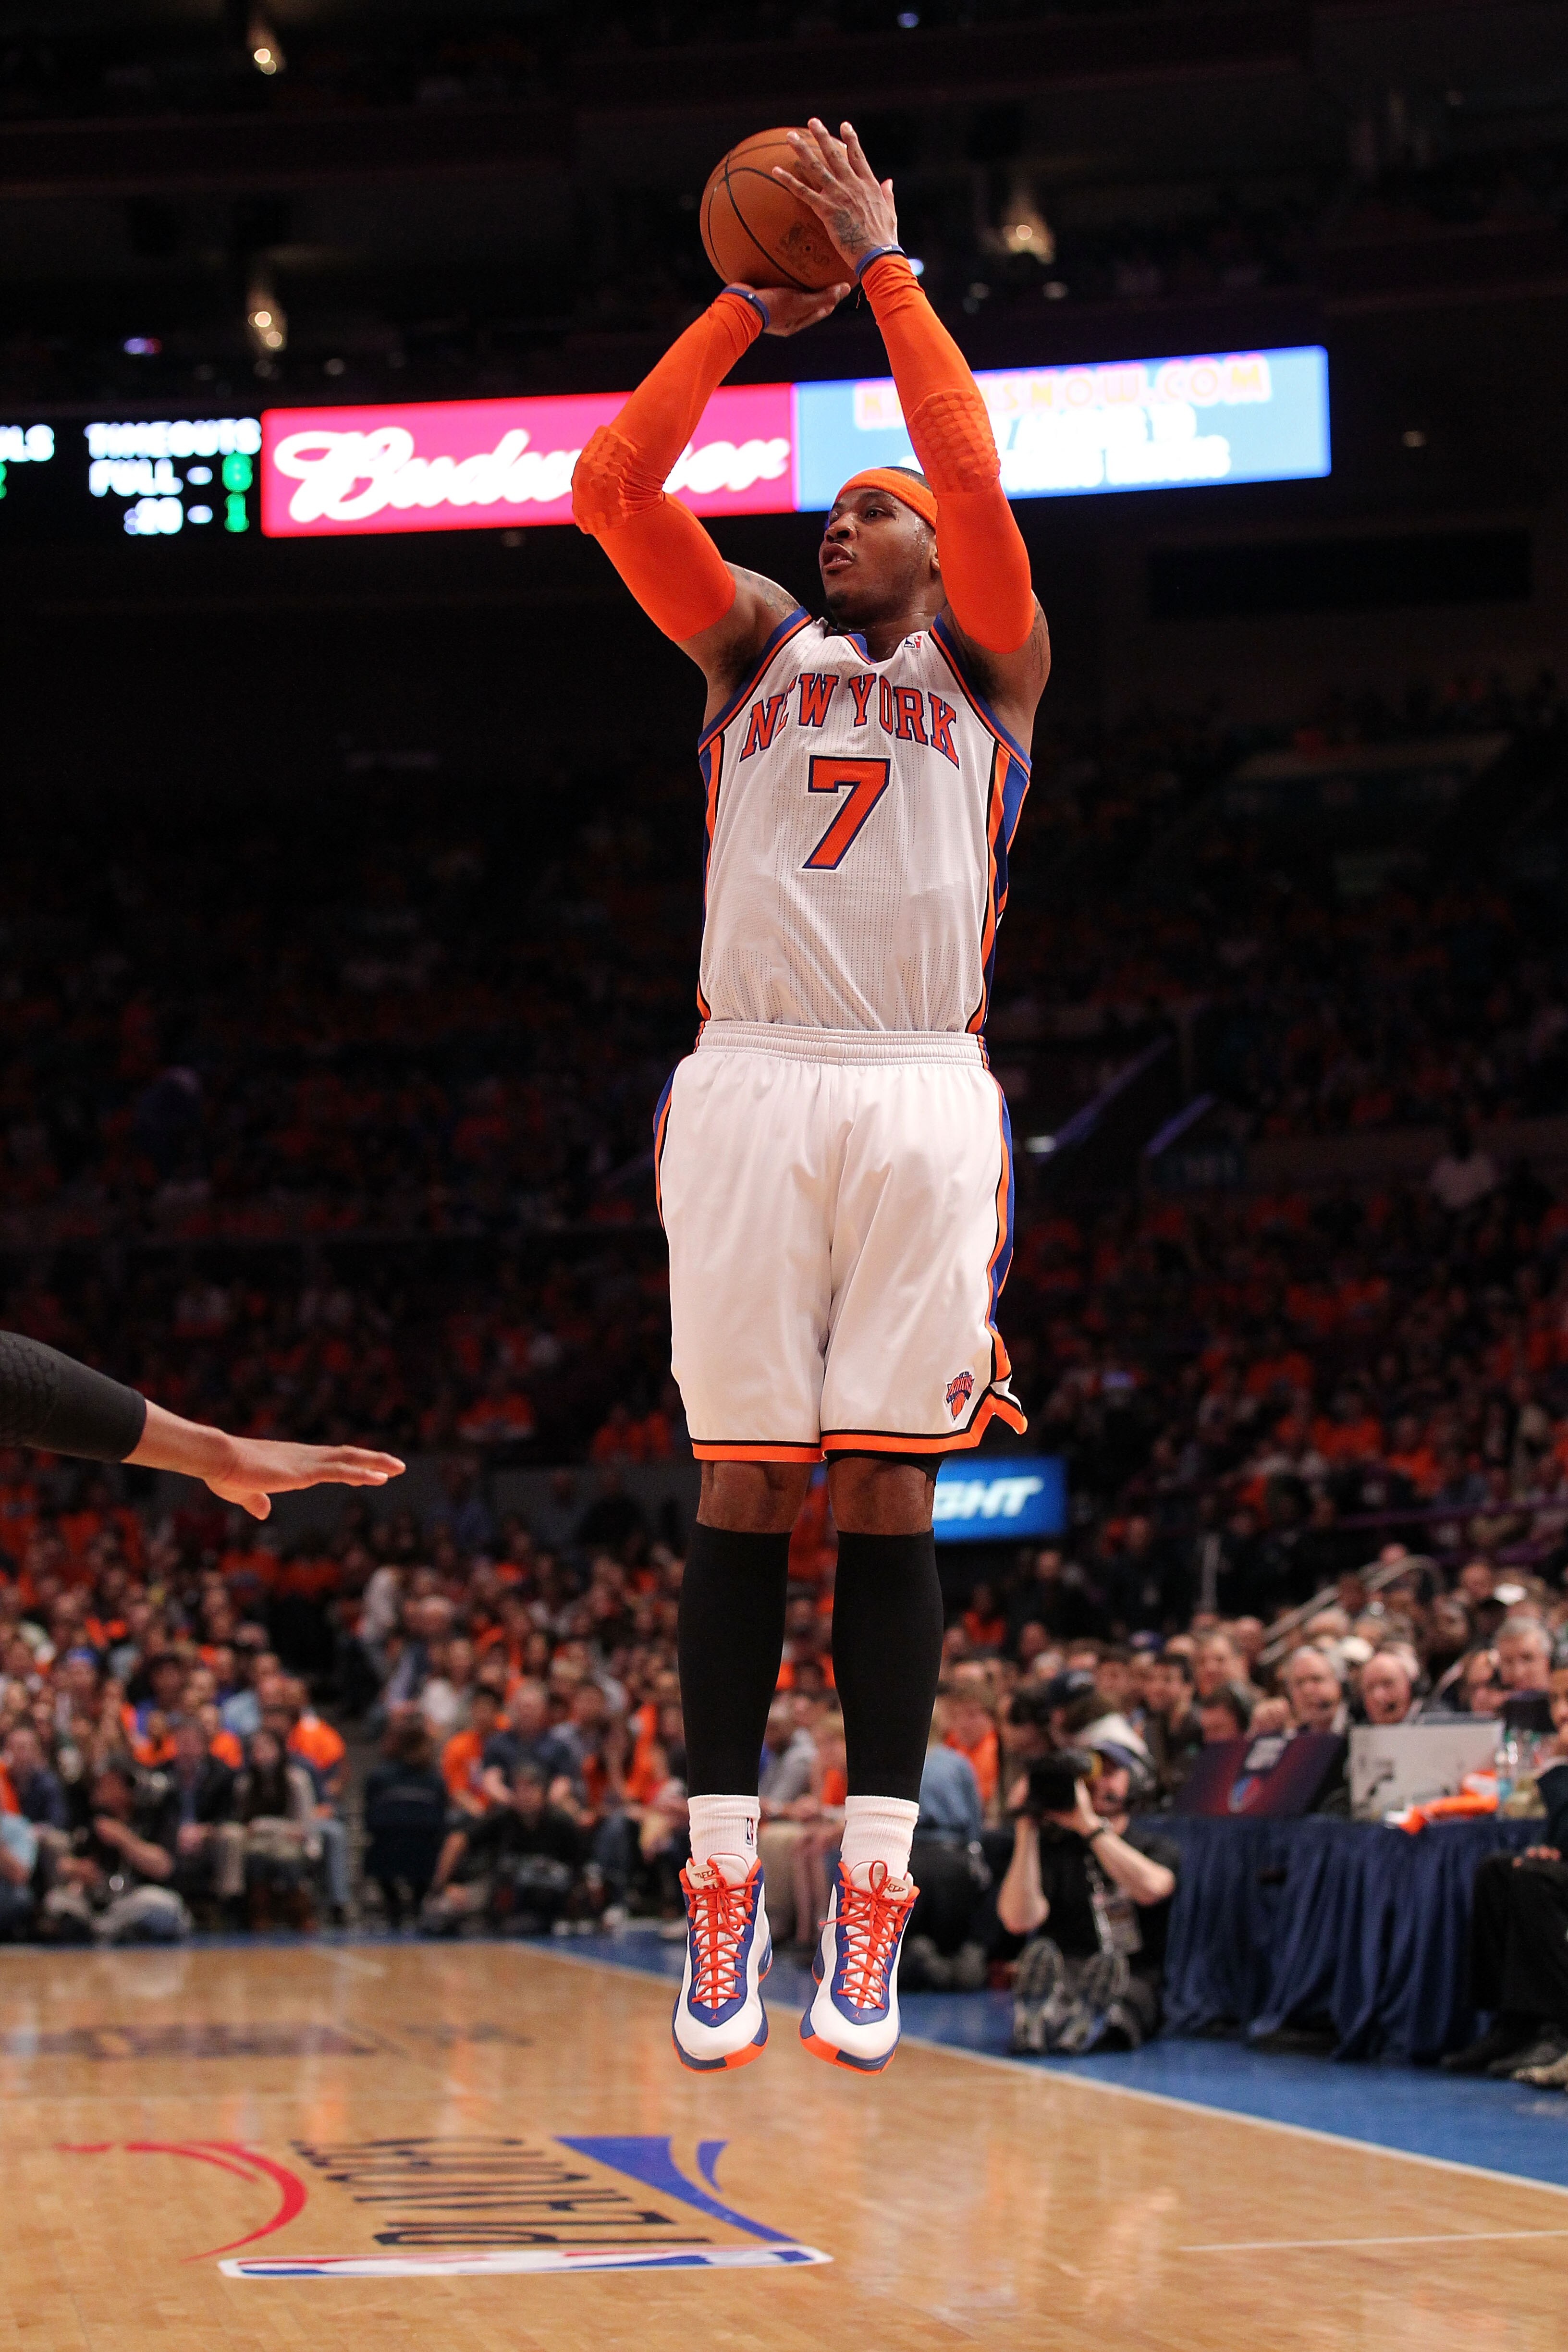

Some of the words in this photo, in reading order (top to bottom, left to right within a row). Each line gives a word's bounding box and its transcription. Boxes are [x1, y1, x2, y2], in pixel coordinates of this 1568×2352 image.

[739, 673, 839, 762] NEW
[848, 673, 960, 771] YORK
[801, 755, 891, 870] 7
[931, 1475, 1044, 1520] GHT
